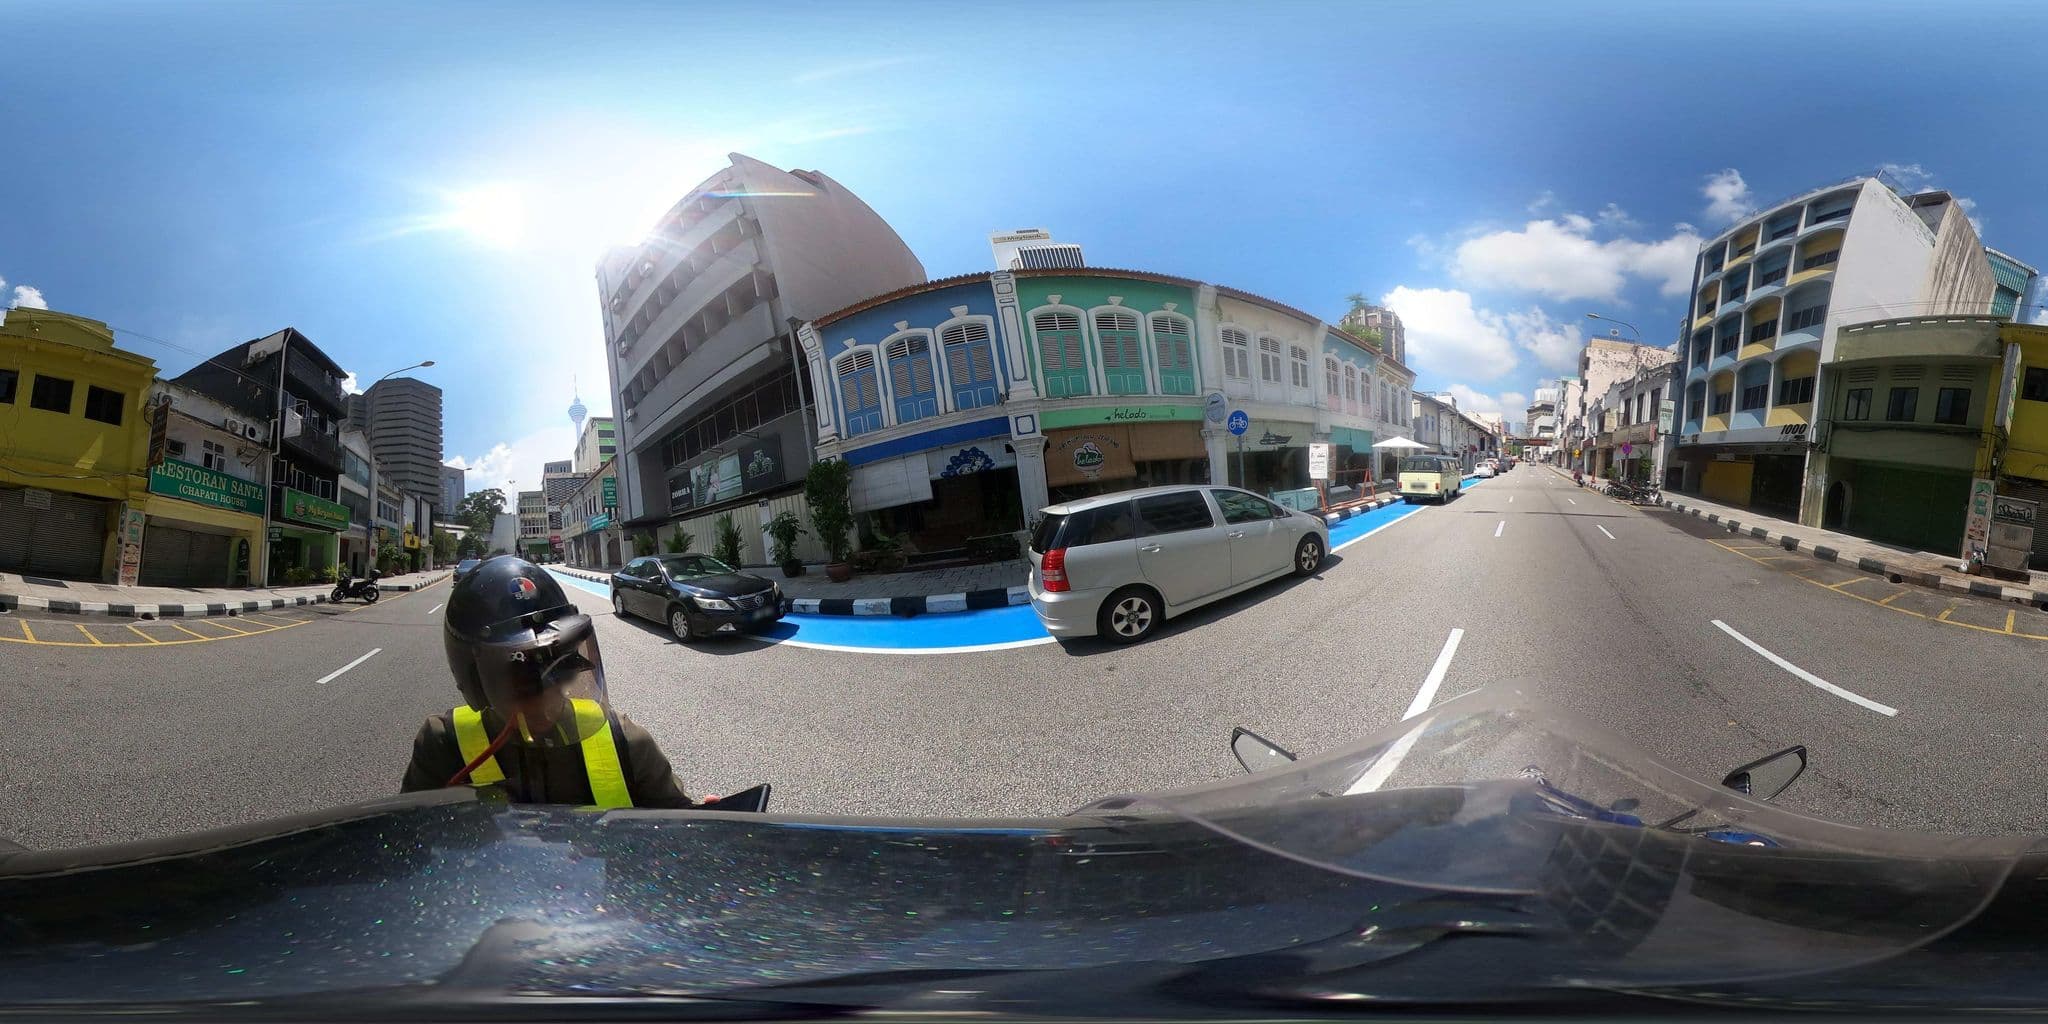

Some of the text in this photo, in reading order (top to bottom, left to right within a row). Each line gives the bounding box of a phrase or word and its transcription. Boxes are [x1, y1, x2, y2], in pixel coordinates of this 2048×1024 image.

[1780, 424, 1808, 434] 1000
[156, 462, 264, 501] RESTORAN SANTA
[179, 484, 247, 508] (CHAPATI HOUSE)
